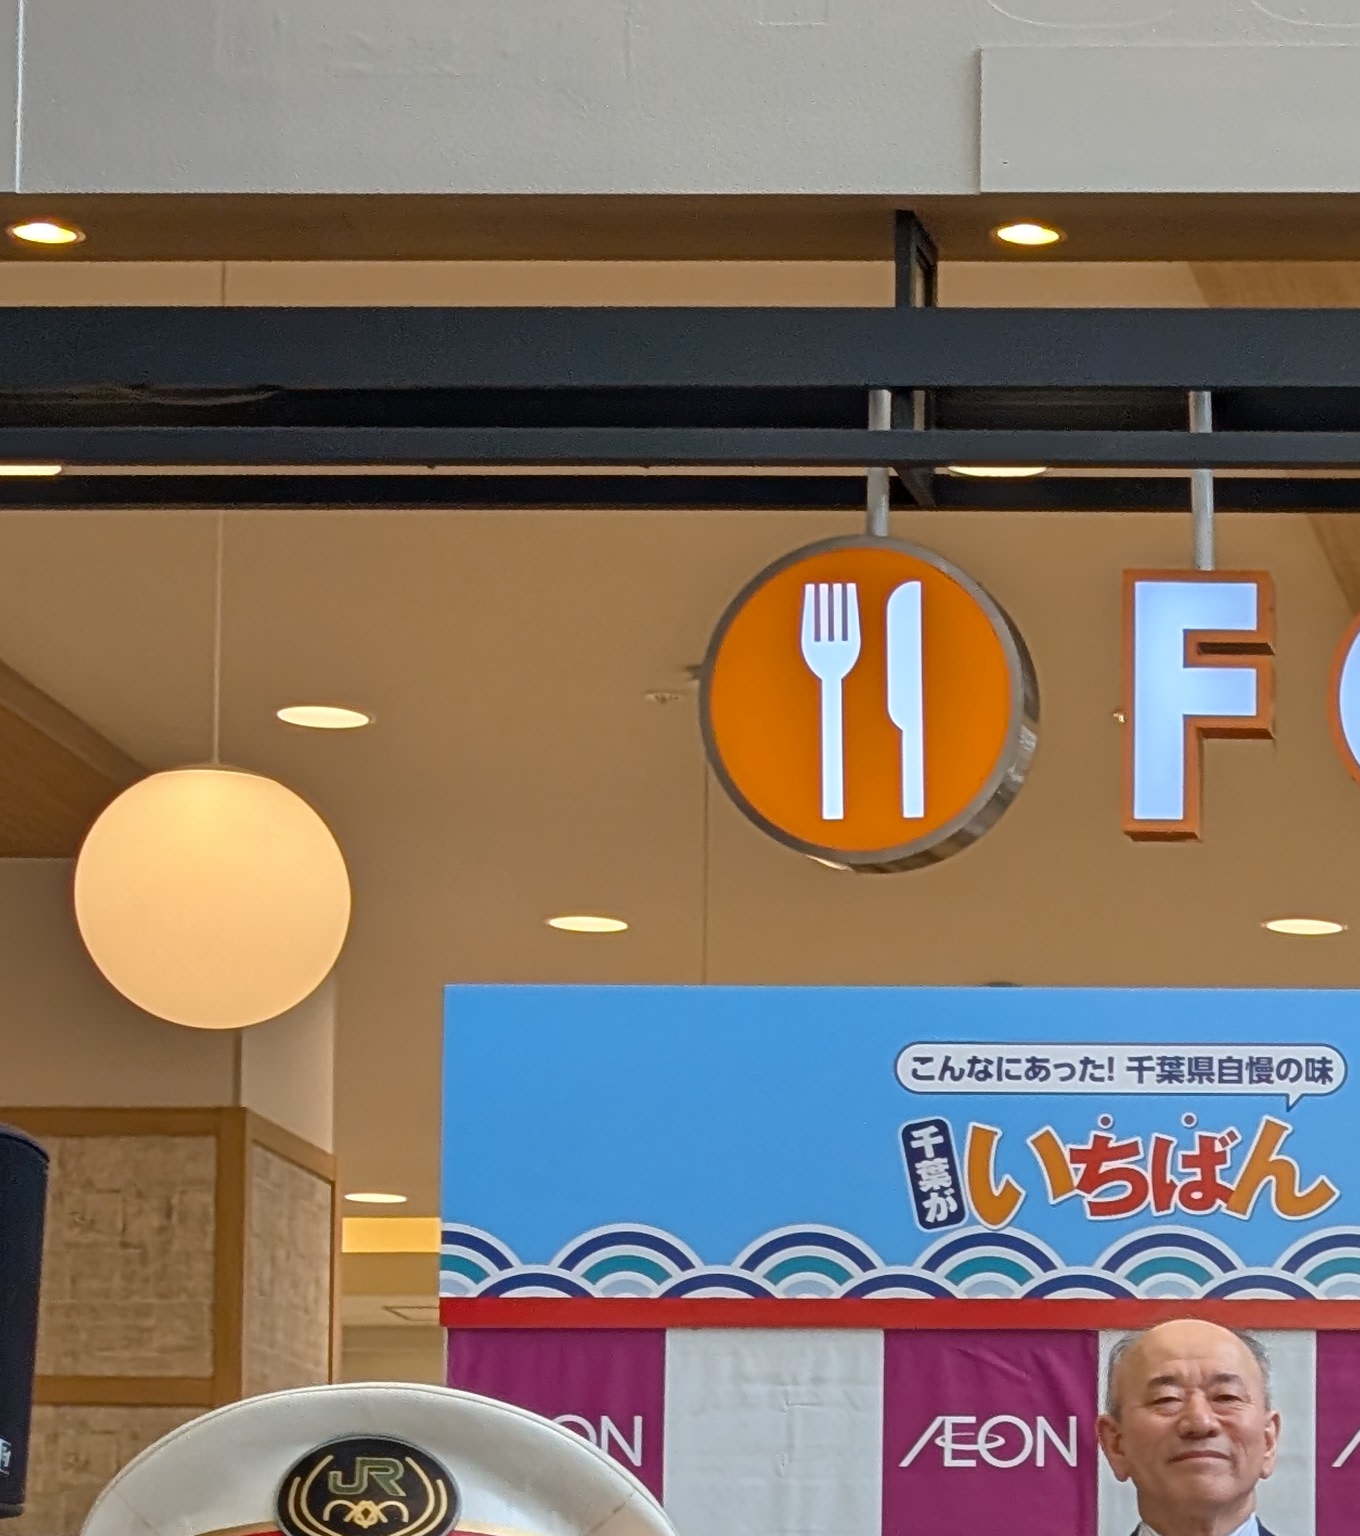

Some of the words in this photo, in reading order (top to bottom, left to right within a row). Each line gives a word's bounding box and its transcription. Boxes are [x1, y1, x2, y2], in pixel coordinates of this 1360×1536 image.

[909, 1126, 960, 1224] 千葉が
[966, 1117, 1338, 1226] いちばん
[328, 1456, 407, 1497] JR
